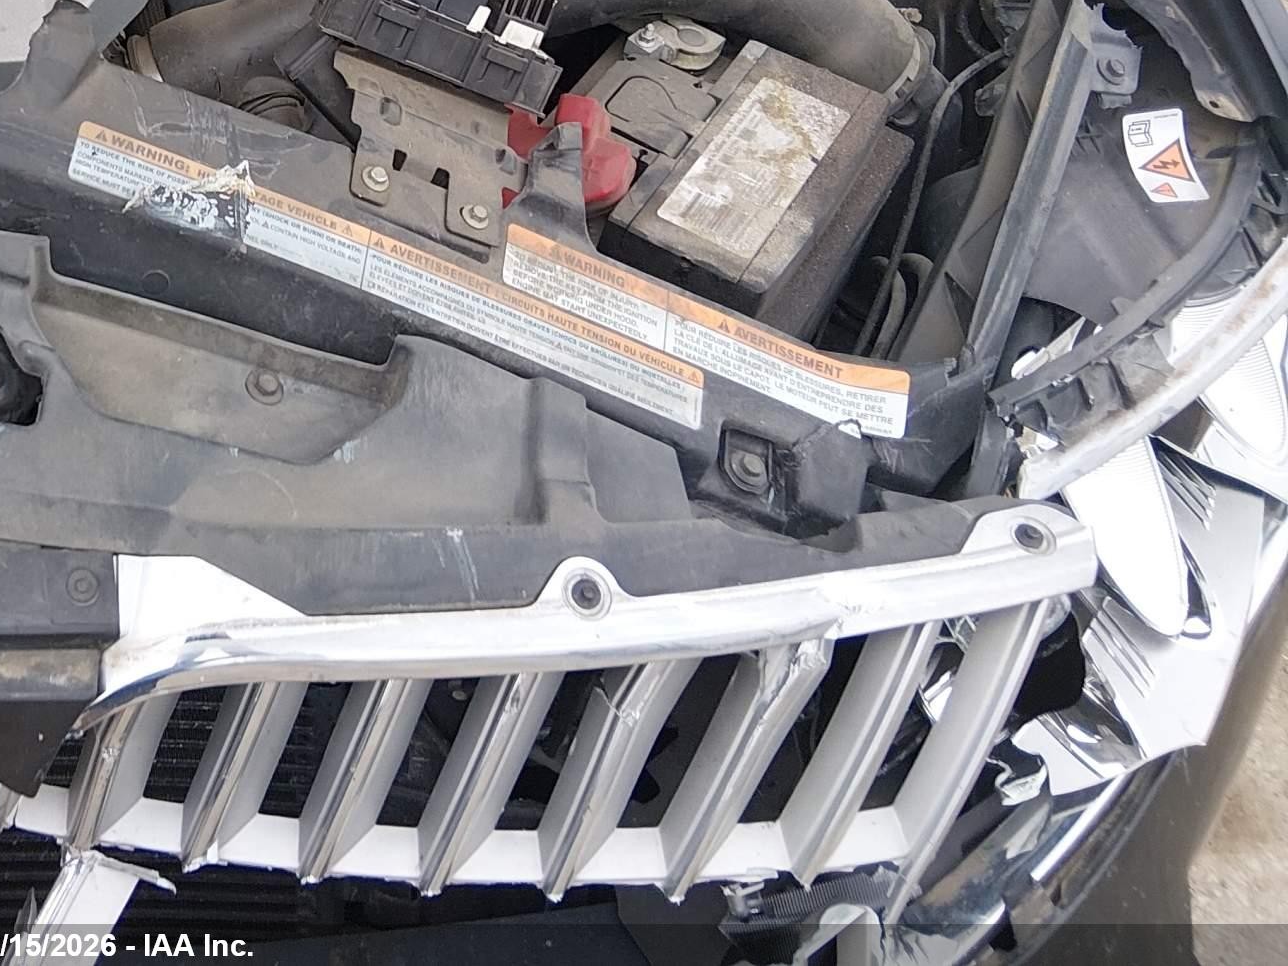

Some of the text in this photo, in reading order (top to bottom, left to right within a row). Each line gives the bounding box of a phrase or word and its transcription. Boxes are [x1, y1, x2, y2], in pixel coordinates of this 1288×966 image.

[110, 134, 190, 173] WARNING:
[287, 203, 337, 230] VEHICLE
[389, 241, 490, 294] AVERTISSEMENT
[547, 310, 577, 331] HAUTE
[581, 325, 621, 351] TENSION
[623, 343, 636, 357] DU
[563, 251, 625, 288] WARNING
[733, 325, 843, 380] AVERTISSEMENT
